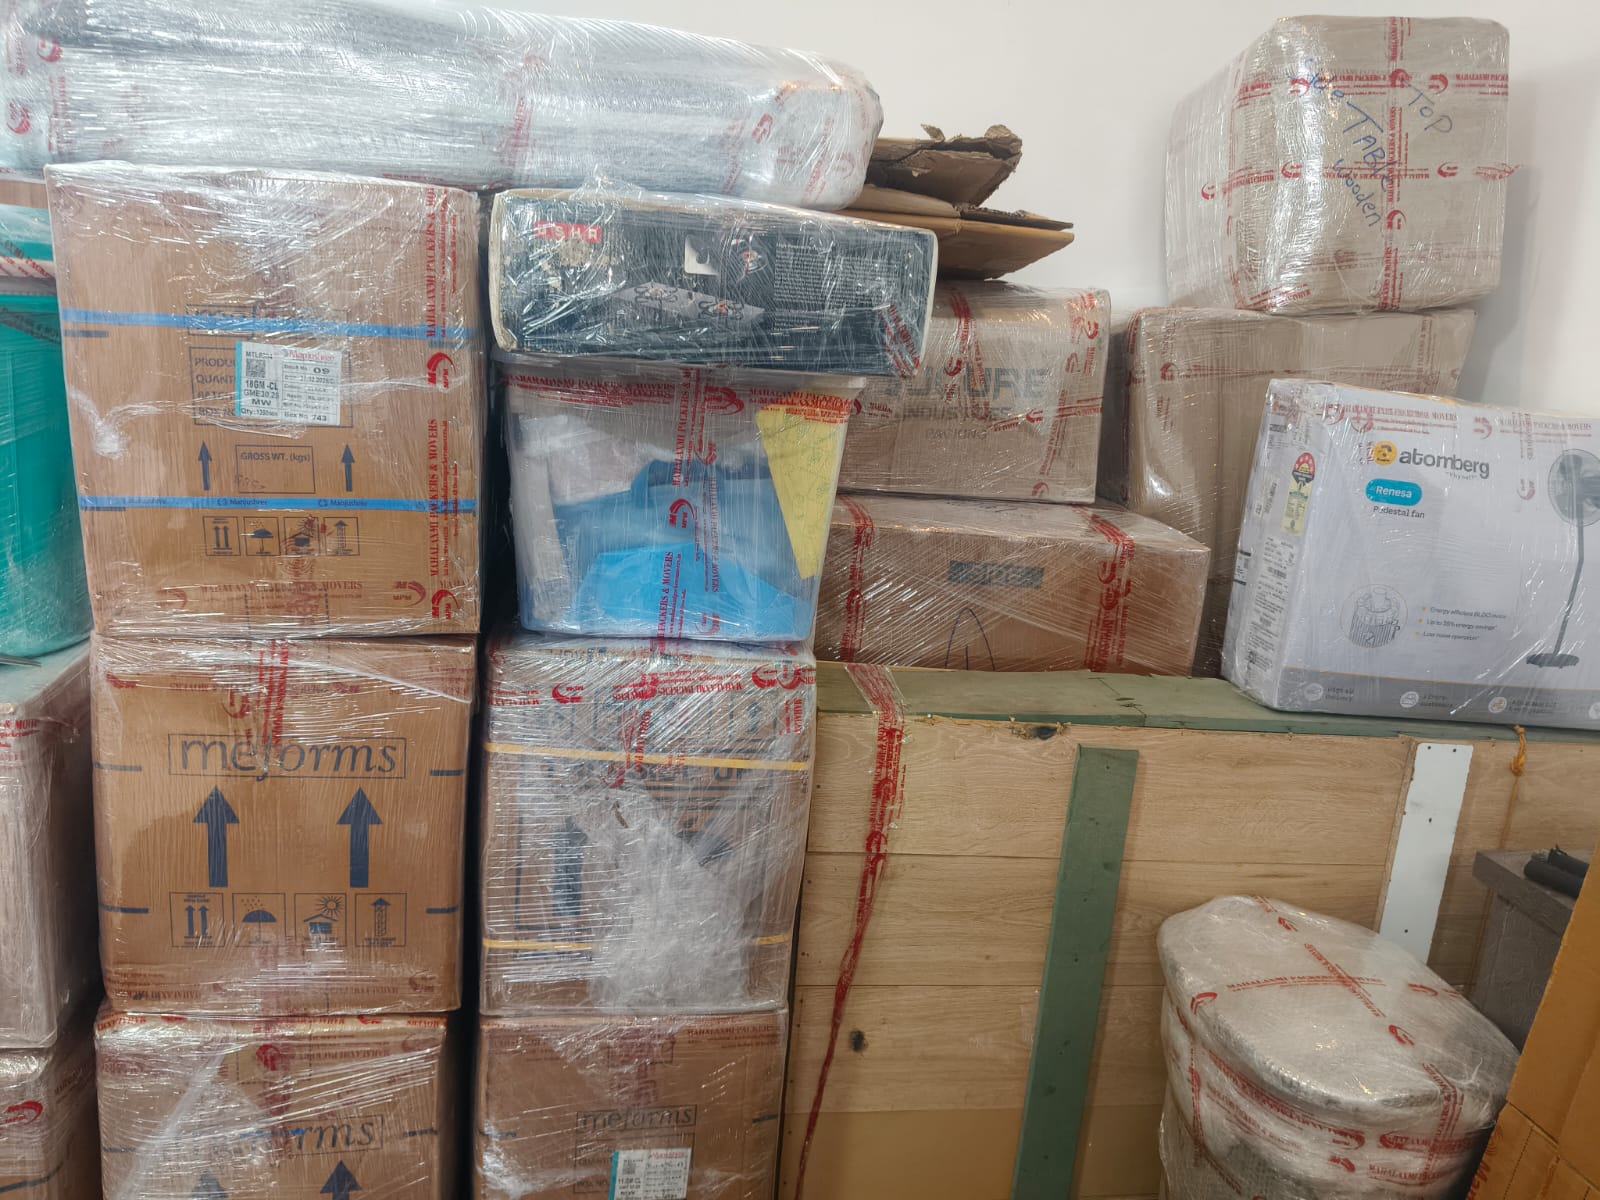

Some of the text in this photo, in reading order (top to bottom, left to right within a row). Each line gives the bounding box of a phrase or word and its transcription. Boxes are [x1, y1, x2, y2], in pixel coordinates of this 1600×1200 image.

[313, 367, 330, 375] 09
[427, 418, 438, 460] MOVERS
[240, 451, 270, 461] GROSS
[1398, 447, 1490, 480] atomberg
[1376, 485, 1413, 499] Renesa
[1411, 510, 1425, 519] fan
[429, 522, 440, 577] MAHALAXMI
[661, 551, 674, 585] MOVERS
